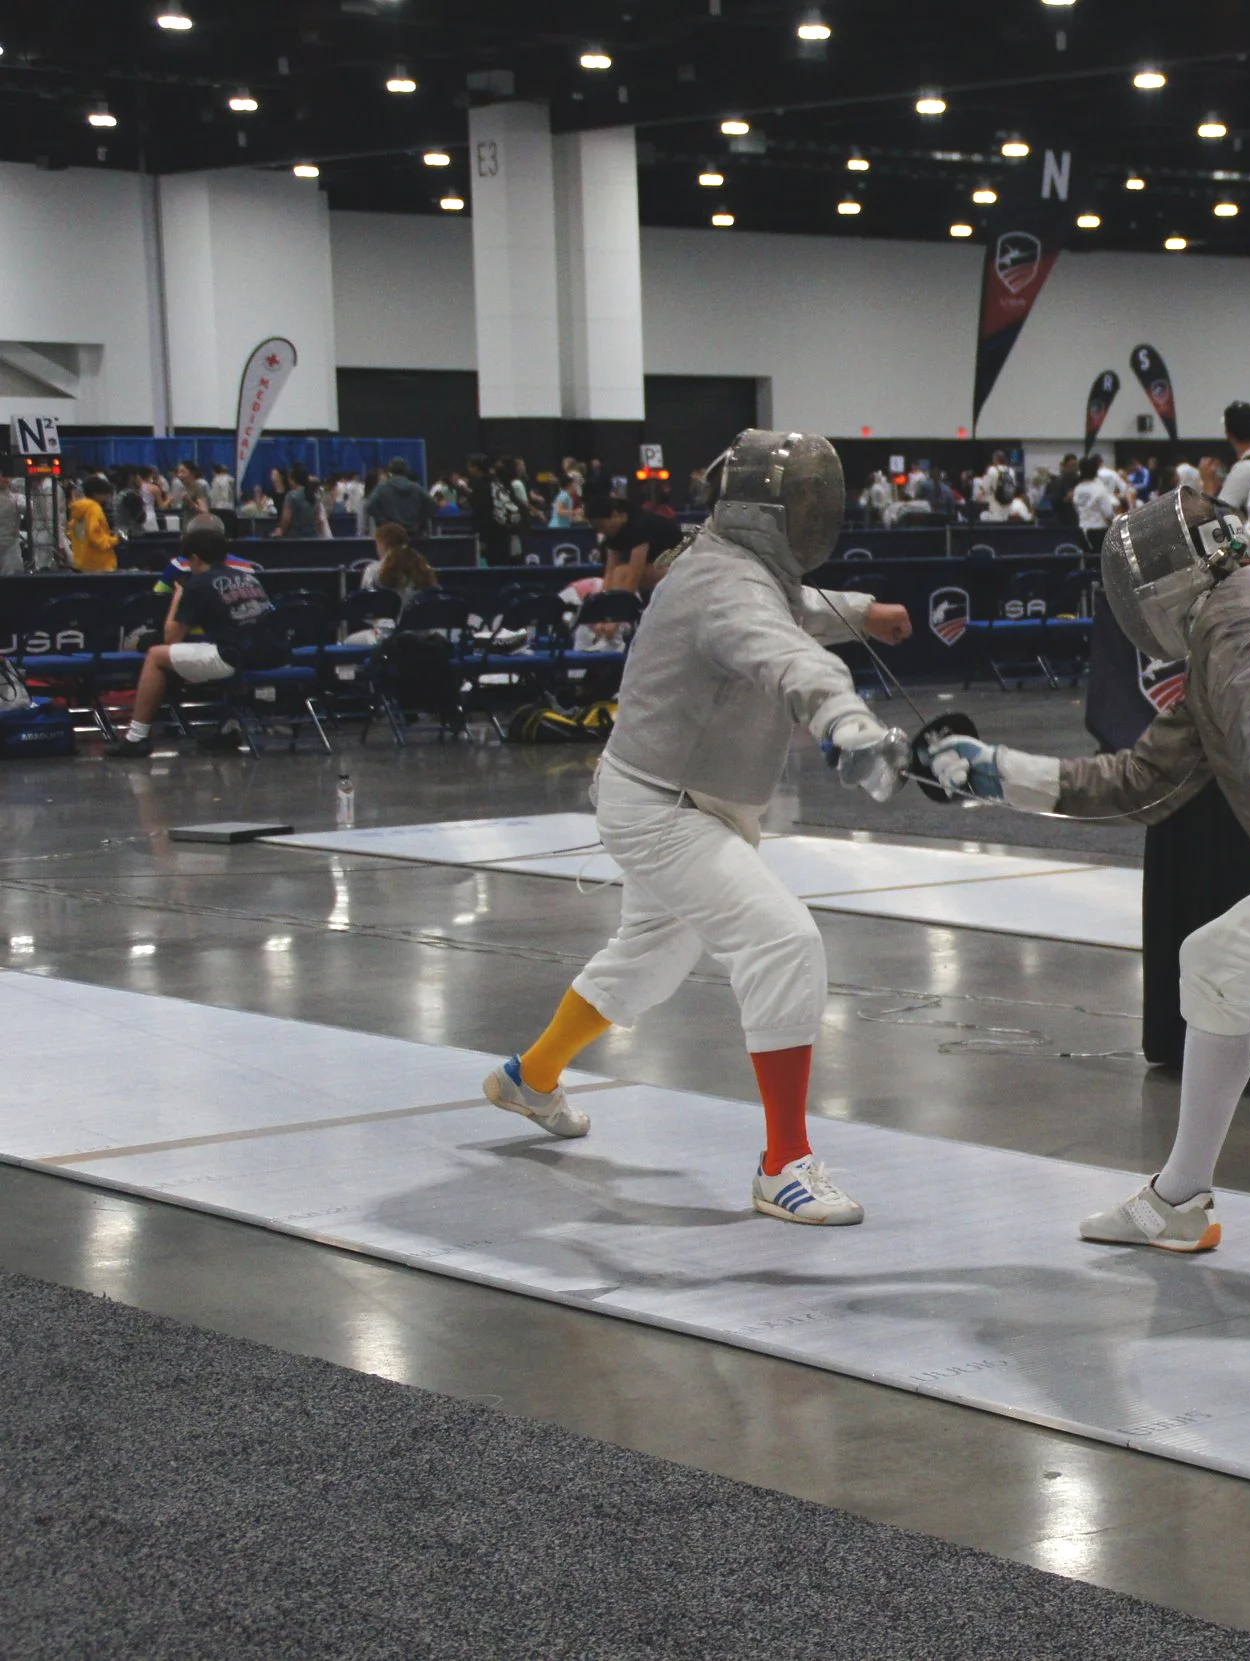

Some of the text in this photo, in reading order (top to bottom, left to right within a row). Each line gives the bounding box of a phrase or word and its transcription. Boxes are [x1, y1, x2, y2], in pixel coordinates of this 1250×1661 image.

[477, 142, 498, 176] E3
[1041, 148, 1071, 201] N
[1139, 348, 1151, 370] S
